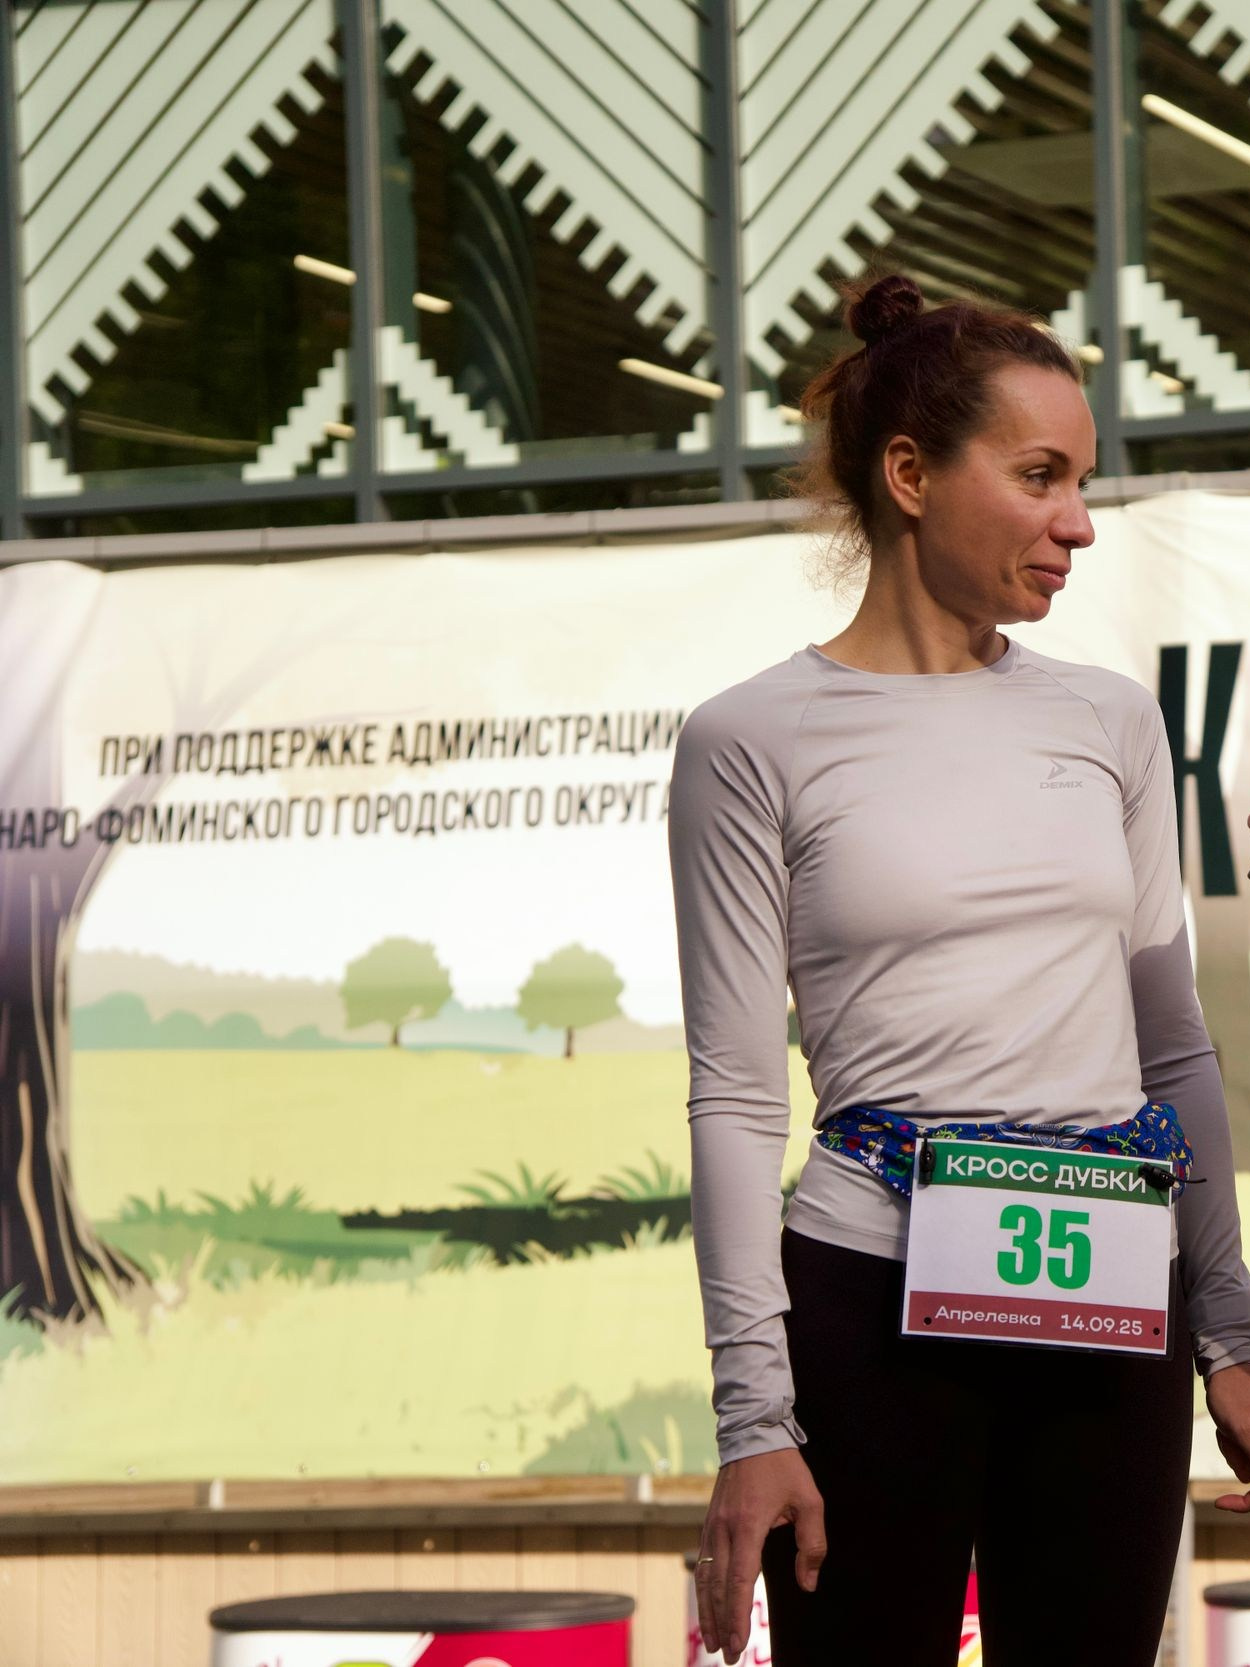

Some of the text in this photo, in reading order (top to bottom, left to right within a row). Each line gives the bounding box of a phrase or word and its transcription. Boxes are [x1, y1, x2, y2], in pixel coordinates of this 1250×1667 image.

[99, 709, 686, 777] ПРИ ПОДДЕРЖКЕ АДМИНИСТРАЦИИ
[1039, 781, 1083, 790] DEMIX
[0, 796, 322, 849] НАРО-ФОМИНСКОГО
[332, 785, 543, 837] ГОРОДСКОГО
[945, 1154, 1147, 1194] КРОСС ДУБКИ
[997, 1204, 1091, 1290] 35
[934, 1304, 1143, 1337] Апрелевка 14.09.25
